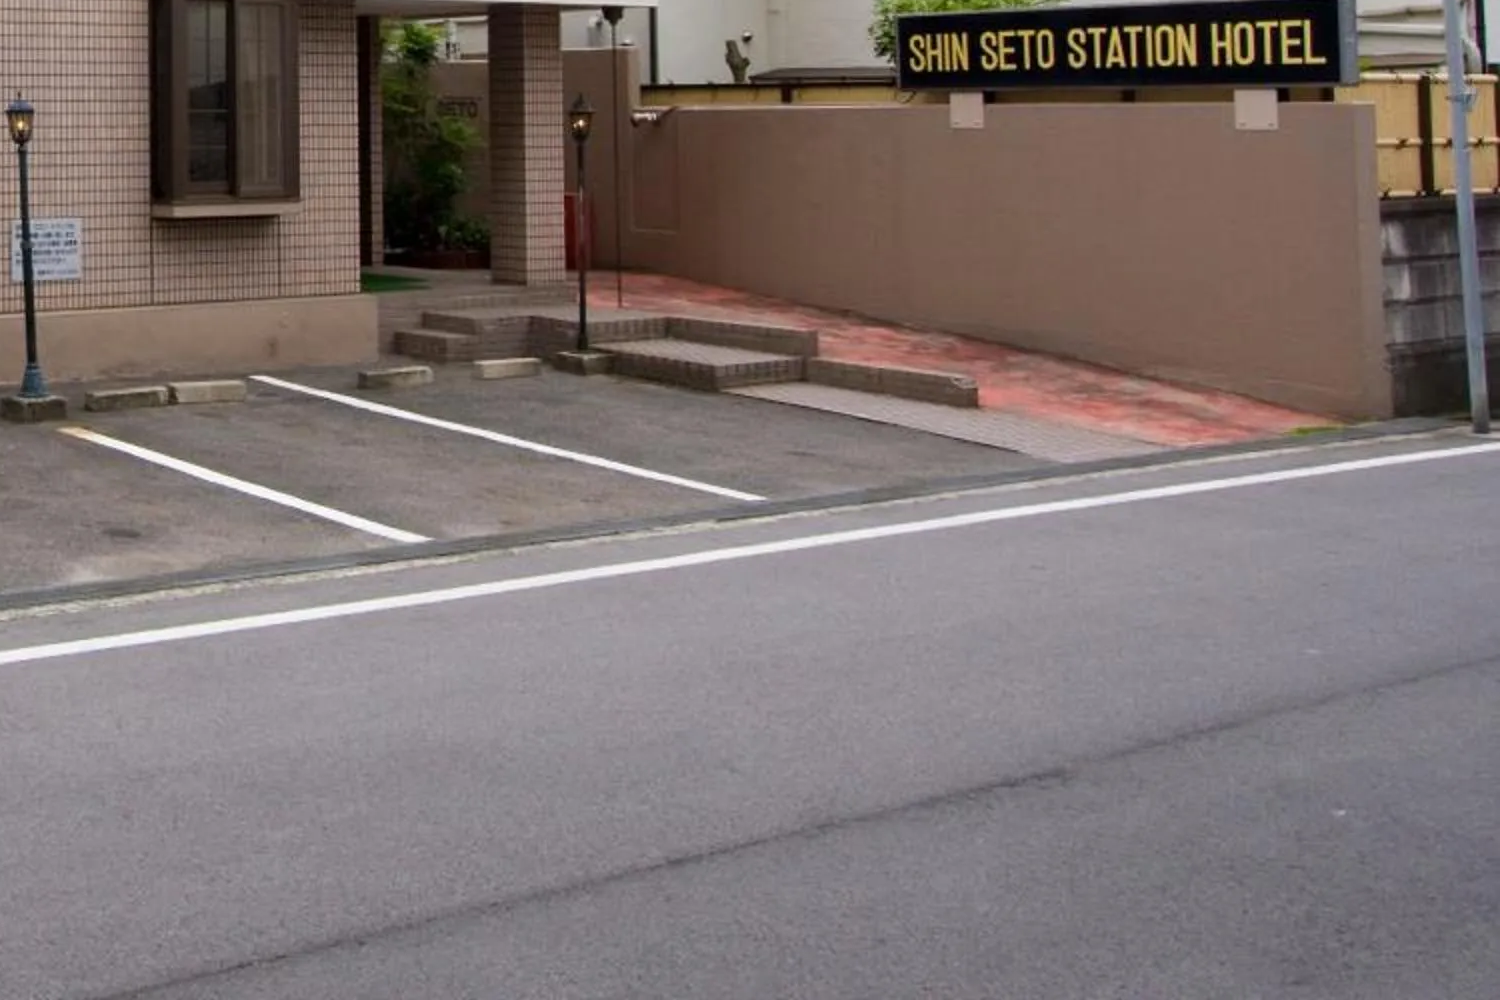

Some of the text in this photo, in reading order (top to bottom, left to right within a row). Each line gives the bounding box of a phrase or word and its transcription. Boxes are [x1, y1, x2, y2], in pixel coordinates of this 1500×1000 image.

[909, 19, 1326, 73] SHIN SETO STATION HOTEL
